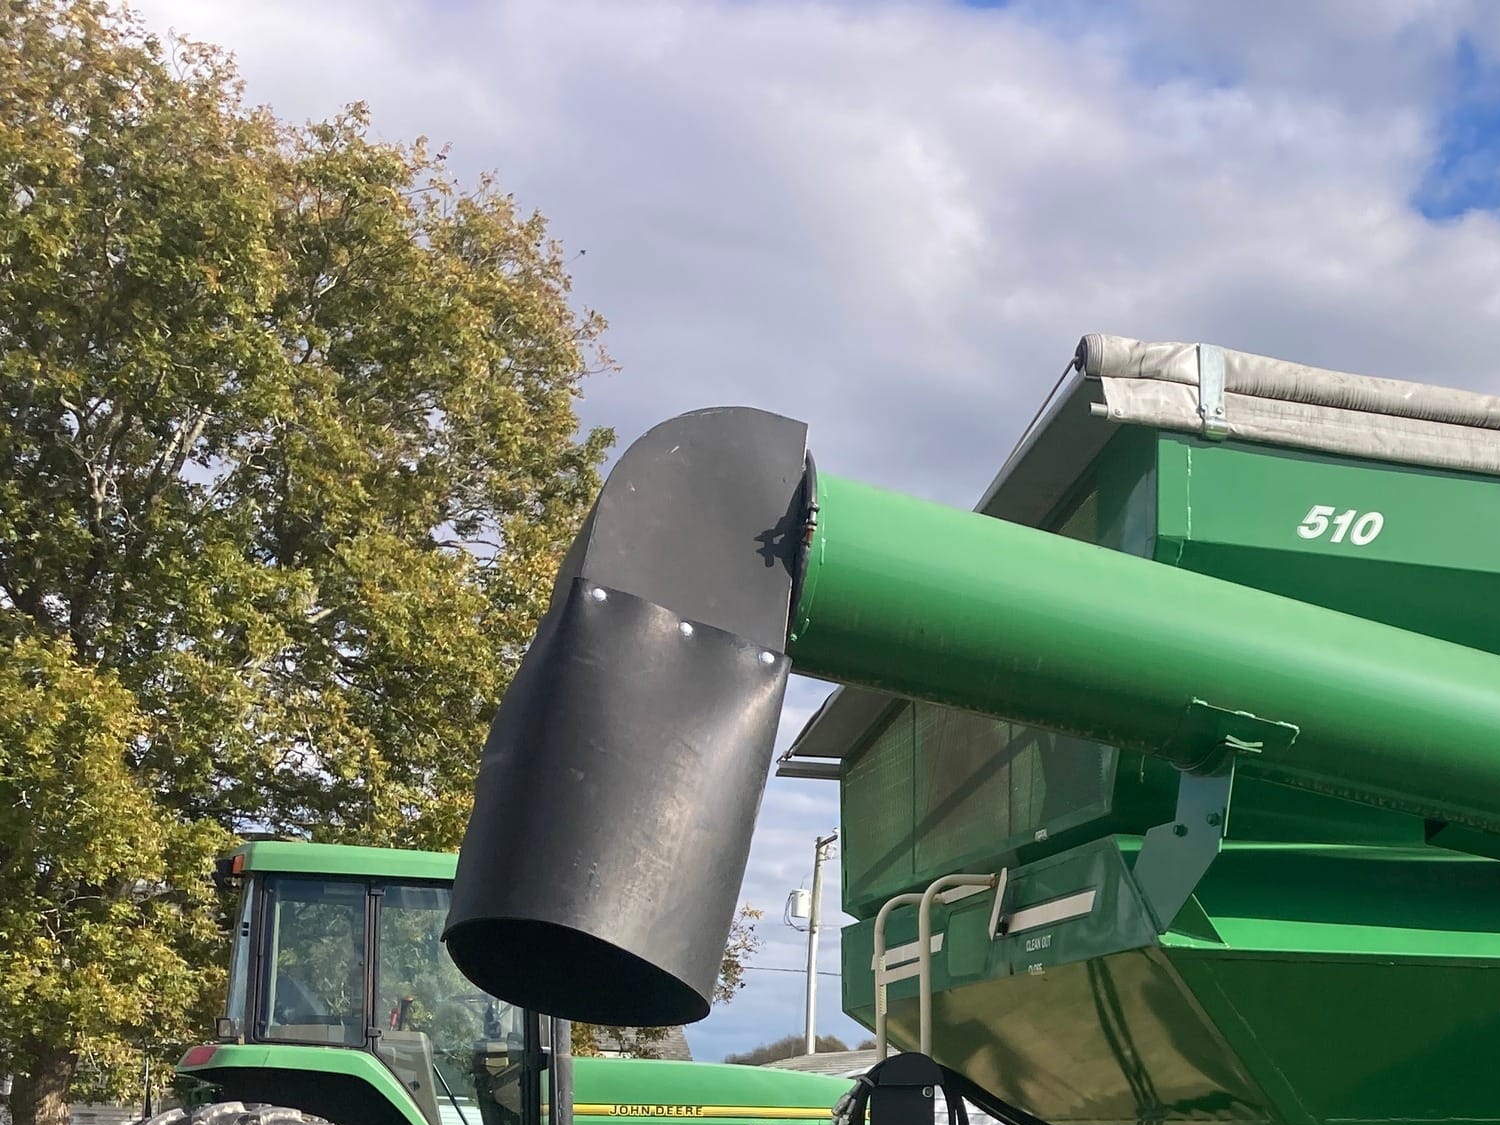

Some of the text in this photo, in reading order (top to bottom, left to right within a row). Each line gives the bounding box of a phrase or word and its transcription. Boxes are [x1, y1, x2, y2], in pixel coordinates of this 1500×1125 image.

[1296, 504, 1384, 546] 510
[1026, 935, 1051, 952] CLEAN OUT
[609, 1105, 703, 1116] JOHN DEERE
